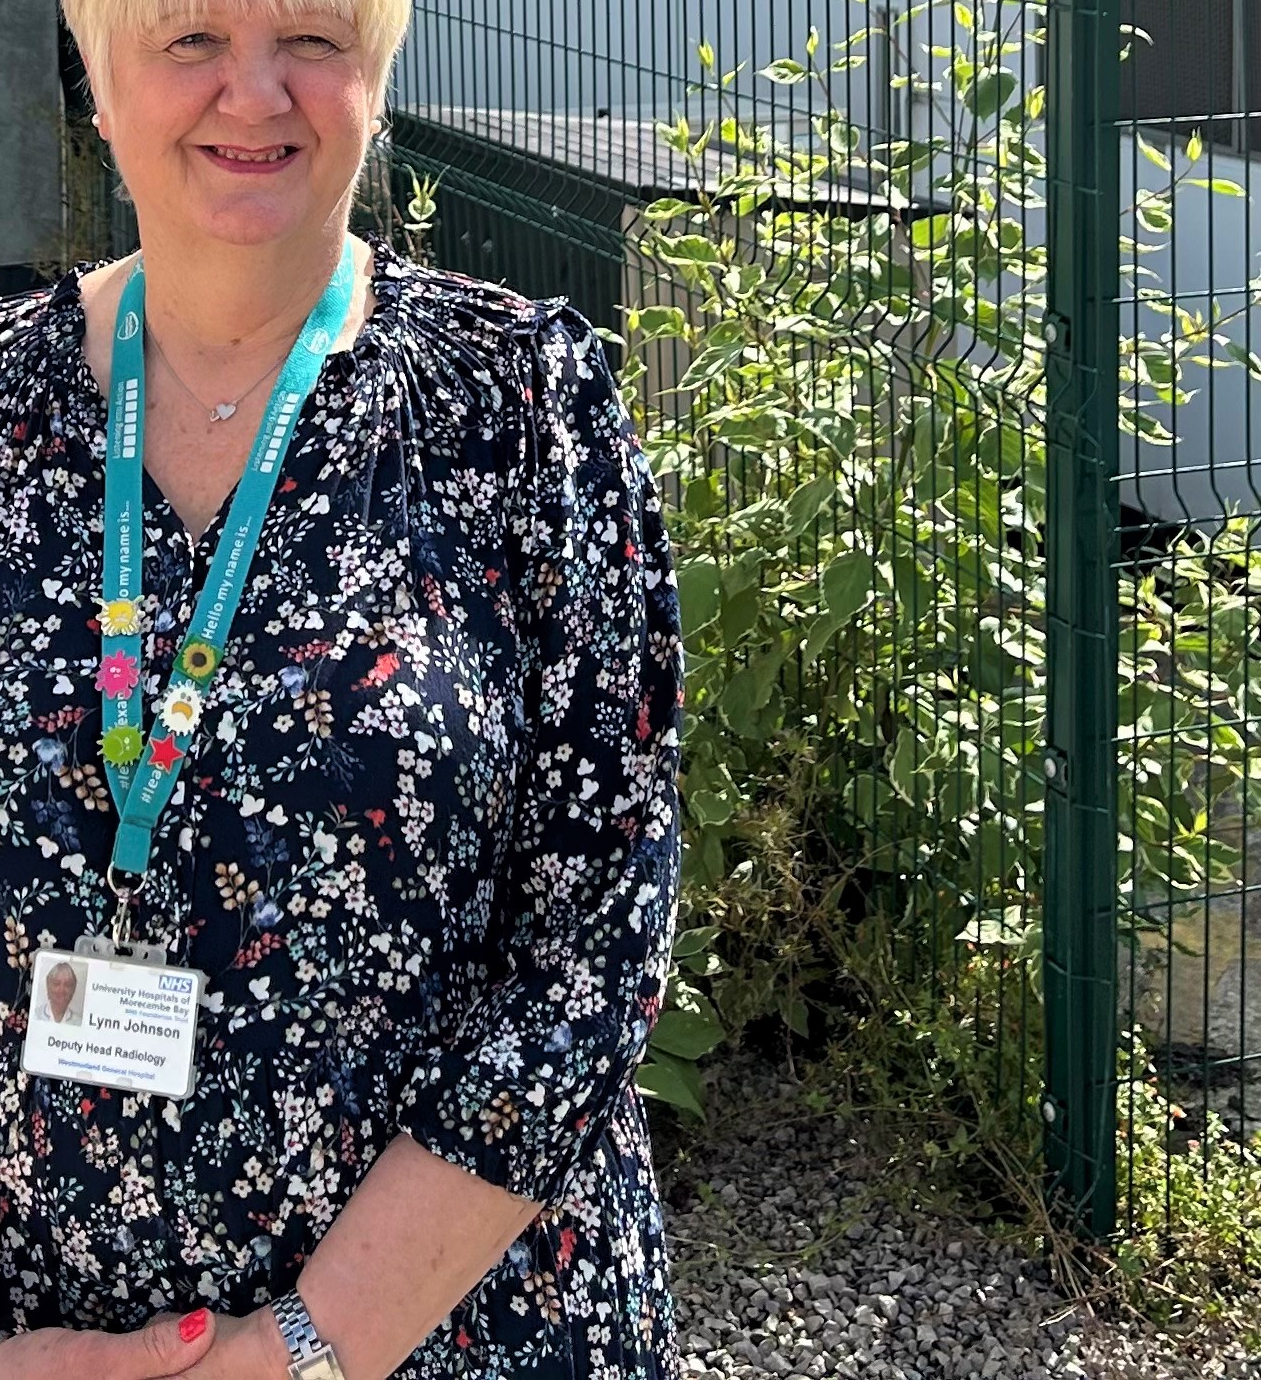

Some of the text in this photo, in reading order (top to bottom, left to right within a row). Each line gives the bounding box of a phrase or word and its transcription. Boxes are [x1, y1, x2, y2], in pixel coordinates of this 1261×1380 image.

[119, 524, 130, 563] name
[225, 539, 245, 577] name
[119, 565, 132, 587] my
[218, 579, 234, 601] my
[201, 603, 223, 640] Hello
[92, 983, 191, 1005] University Hospitals of
[159, 975, 192, 993] NHS
[119, 997, 189, 1018] Morecambe Bay
[88, 1013, 180, 1039] Lynn Johnson
[47, 1035, 167, 1067] Deputy Head Radiology
